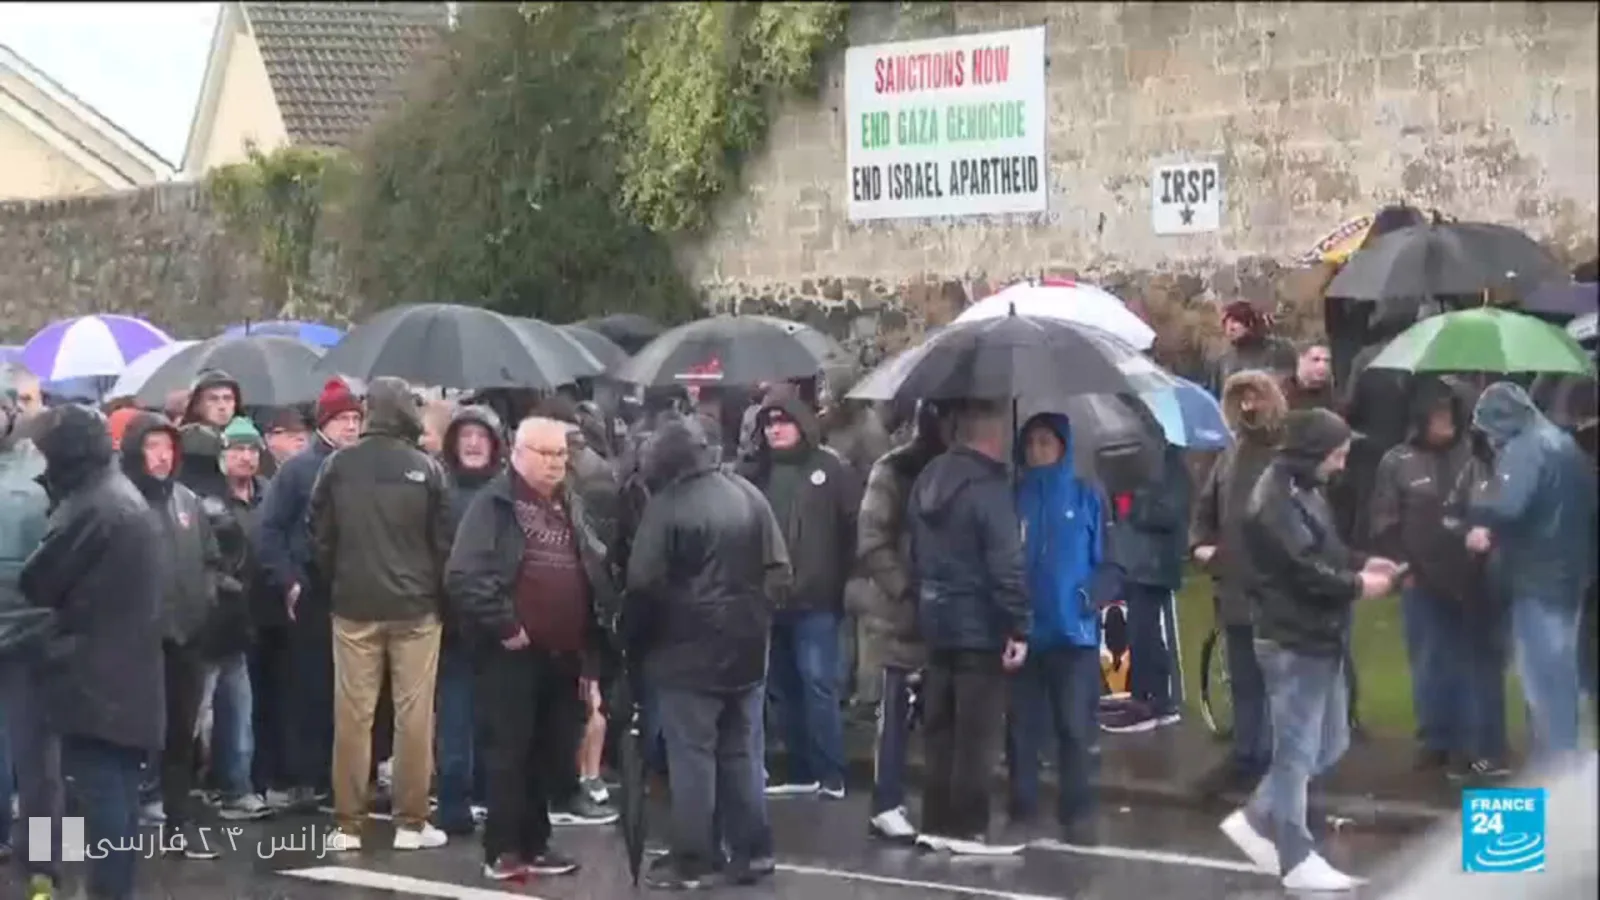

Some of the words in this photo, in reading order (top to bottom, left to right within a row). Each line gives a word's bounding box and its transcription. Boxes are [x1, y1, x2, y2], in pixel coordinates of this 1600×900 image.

[875, 50, 965, 94] SANCTIONS
[972, 45, 1010, 86] NOW
[861, 111, 890, 149] END
[898, 107, 938, 146] GAZA
[946, 100, 1025, 142] GENOCIDE
[852, 165, 881, 201] END
[888, 161, 943, 200] ISRAEL
[949, 155, 1039, 196] APARTHEID
[1160, 168, 1215, 204] IRSP
